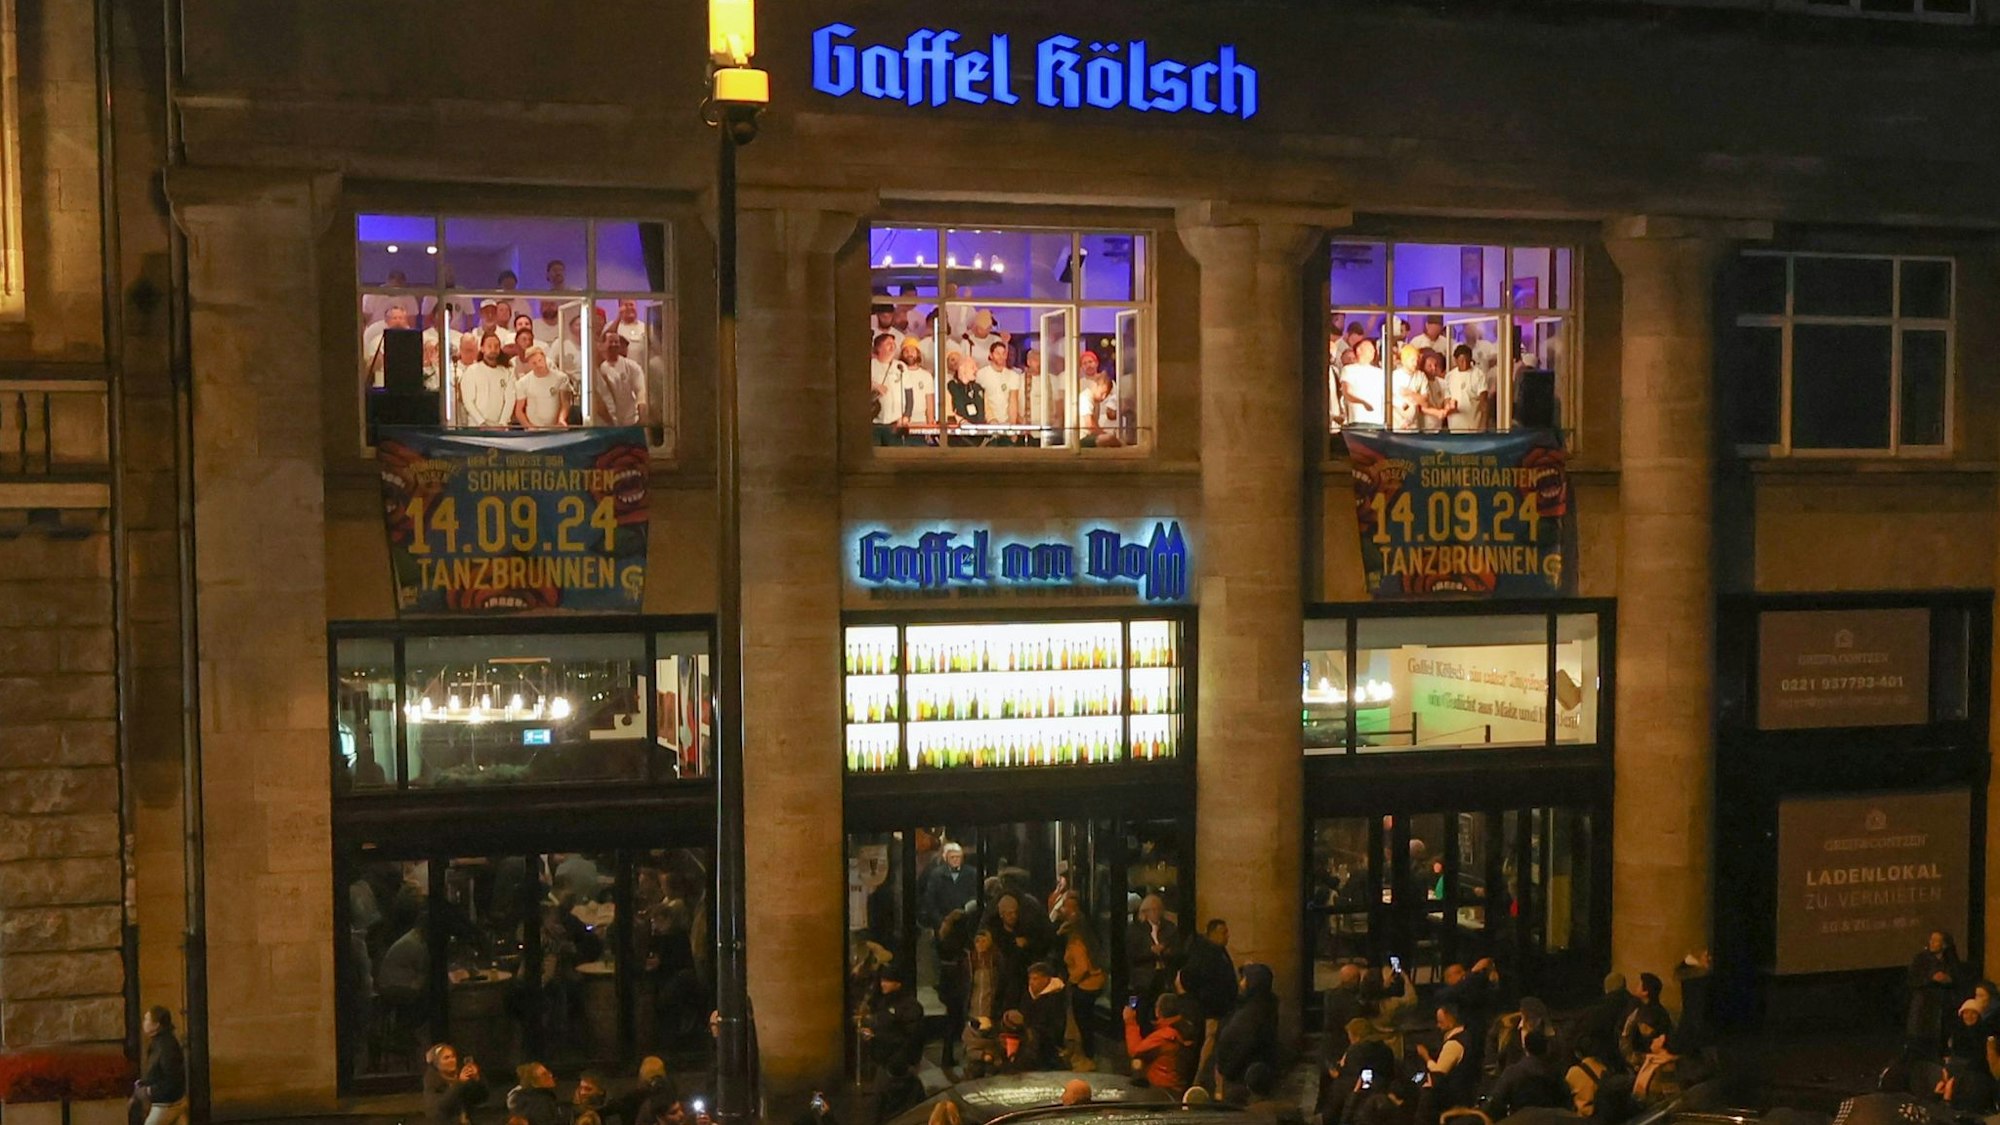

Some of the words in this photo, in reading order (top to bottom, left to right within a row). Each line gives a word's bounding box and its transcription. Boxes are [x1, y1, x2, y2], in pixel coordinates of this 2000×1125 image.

[811, 22, 1019, 108] Gaffel
[1036, 33, 1258, 121] Kölsch
[467, 468, 616, 492] SOMMERGARTEN
[1420, 467, 1538, 488] SOMMERGARTEN
[406, 495, 618, 554] 14.09.24
[1370, 490, 1540, 543] 14.09.24
[416, 556, 616, 591] TANZBRUNNEN
[859, 530, 993, 587] Gaffel
[1001, 543, 1074, 582] am
[1379, 545, 1539, 576] TANZBRUNNEN
[1781, 678, 1816, 692] 0221
[1806, 863, 1943, 886] LADENLOKAL
[1805, 892, 1828, 911] ZU
[1839, 887, 1943, 908] VERMIETEN
